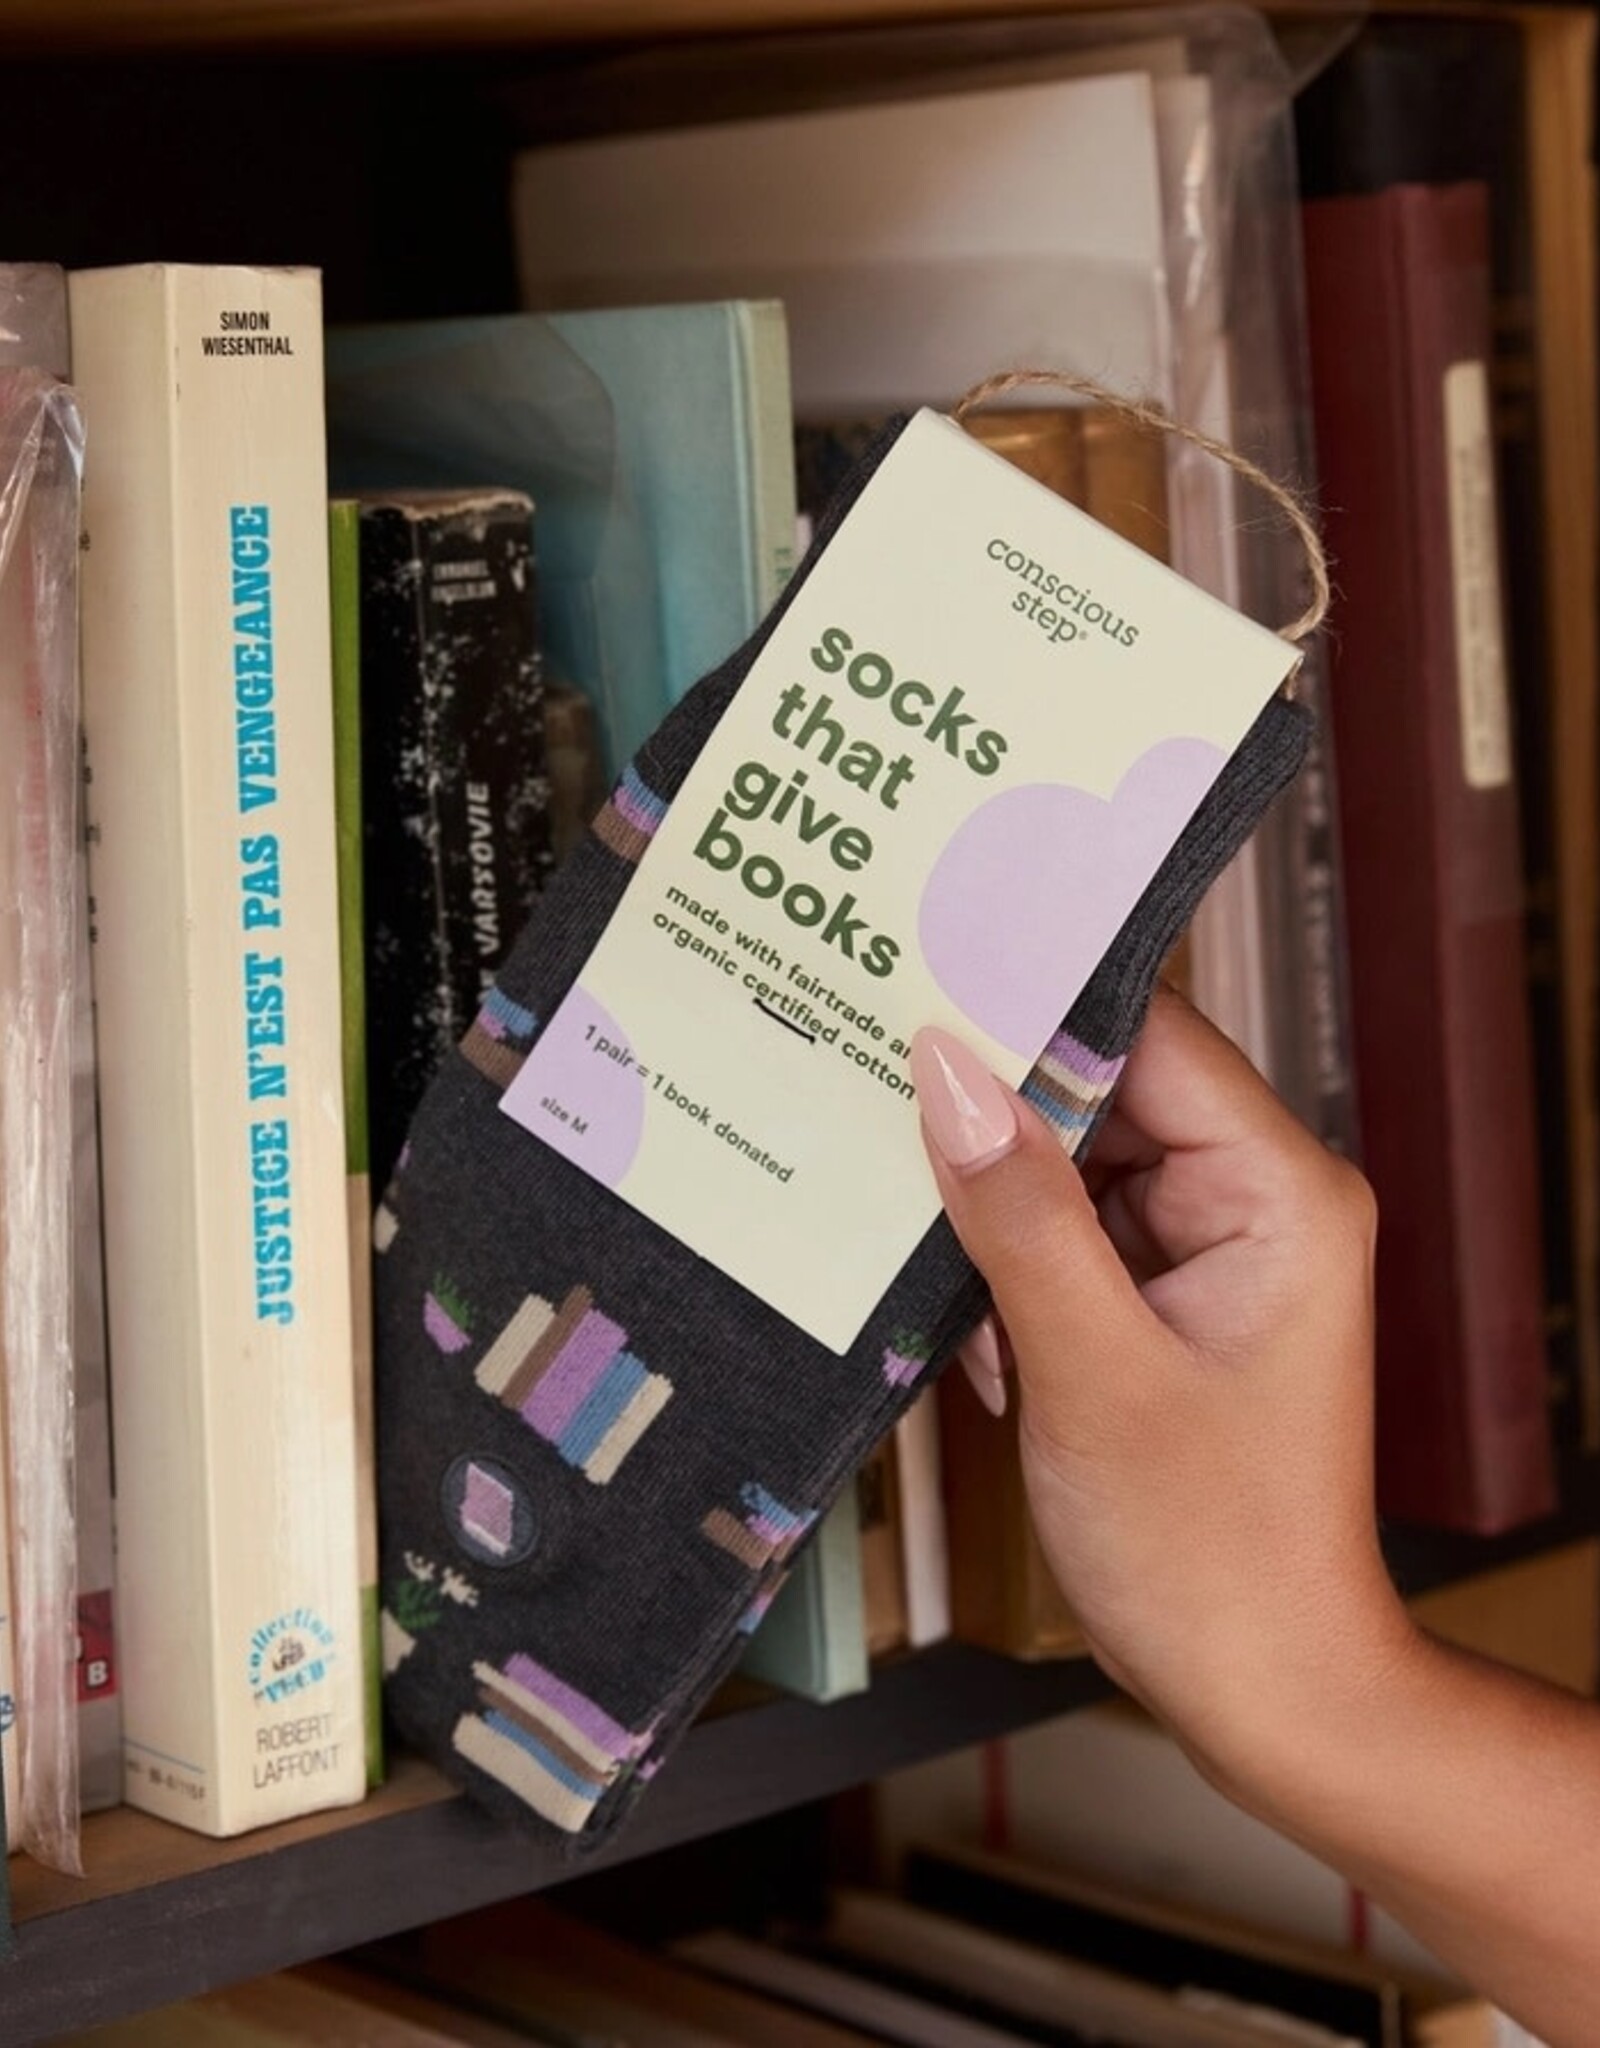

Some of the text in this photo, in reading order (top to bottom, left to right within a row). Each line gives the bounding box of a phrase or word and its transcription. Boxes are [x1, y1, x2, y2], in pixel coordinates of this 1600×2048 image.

[201, 336, 294, 356] WIESENTHAL
[220, 311, 270, 331] SIMON
[986, 538, 1140, 648] conscious
[771, 682, 917, 811] that
[810, 626, 1009, 777] socks
[466, 781, 500, 956] VARSOVIE
[723, 760, 874, 872] give
[230, 506, 295, 1325] JUSTICE N'EST PAS VENGEANCE
[692, 807, 902, 979] books
[652, 911, 917, 1101] organic certified cotton
[665, 886, 731, 935] made
[734, 930, 783, 971] with
[786, 963, 886, 1041] fairtrade
[540, 1096, 589, 1136] size M
[584, 1024, 598, 1041] 1
[593, 1036, 634, 1068] pair
[652, 1073, 665, 1091] 1
[663, 1082, 712, 1127] book
[713, 1121, 795, 1183] donated
[253, 1743, 341, 1789] LAFFONT
[256, 1713, 332, 1754] ROBERT
